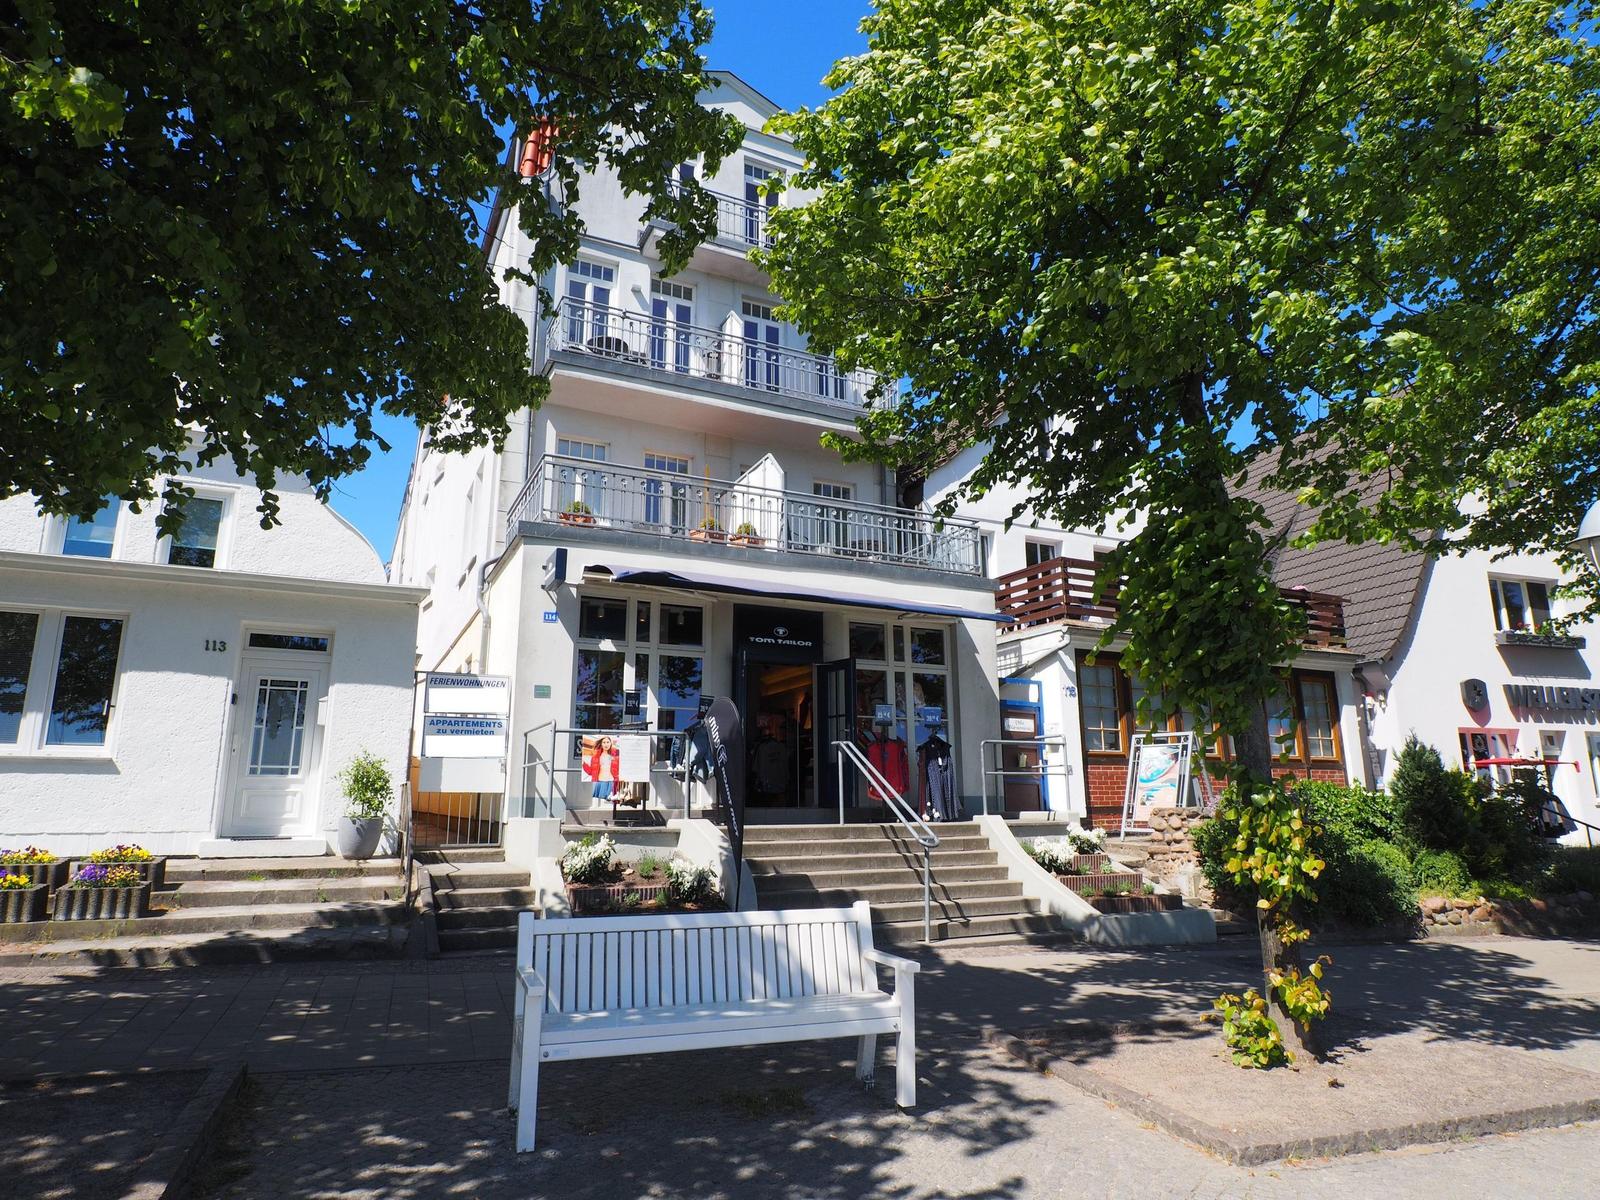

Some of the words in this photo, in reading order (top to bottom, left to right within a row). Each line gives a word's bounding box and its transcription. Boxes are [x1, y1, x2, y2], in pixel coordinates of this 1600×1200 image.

[205, 640, 226, 652] 113
[777, 639, 813, 647] TAILOR
[428, 677, 507, 689] FERIENWOHNUNGEN
[428, 719, 503, 729] APPARTEMENTS
[450, 728, 495, 736] vermieten
